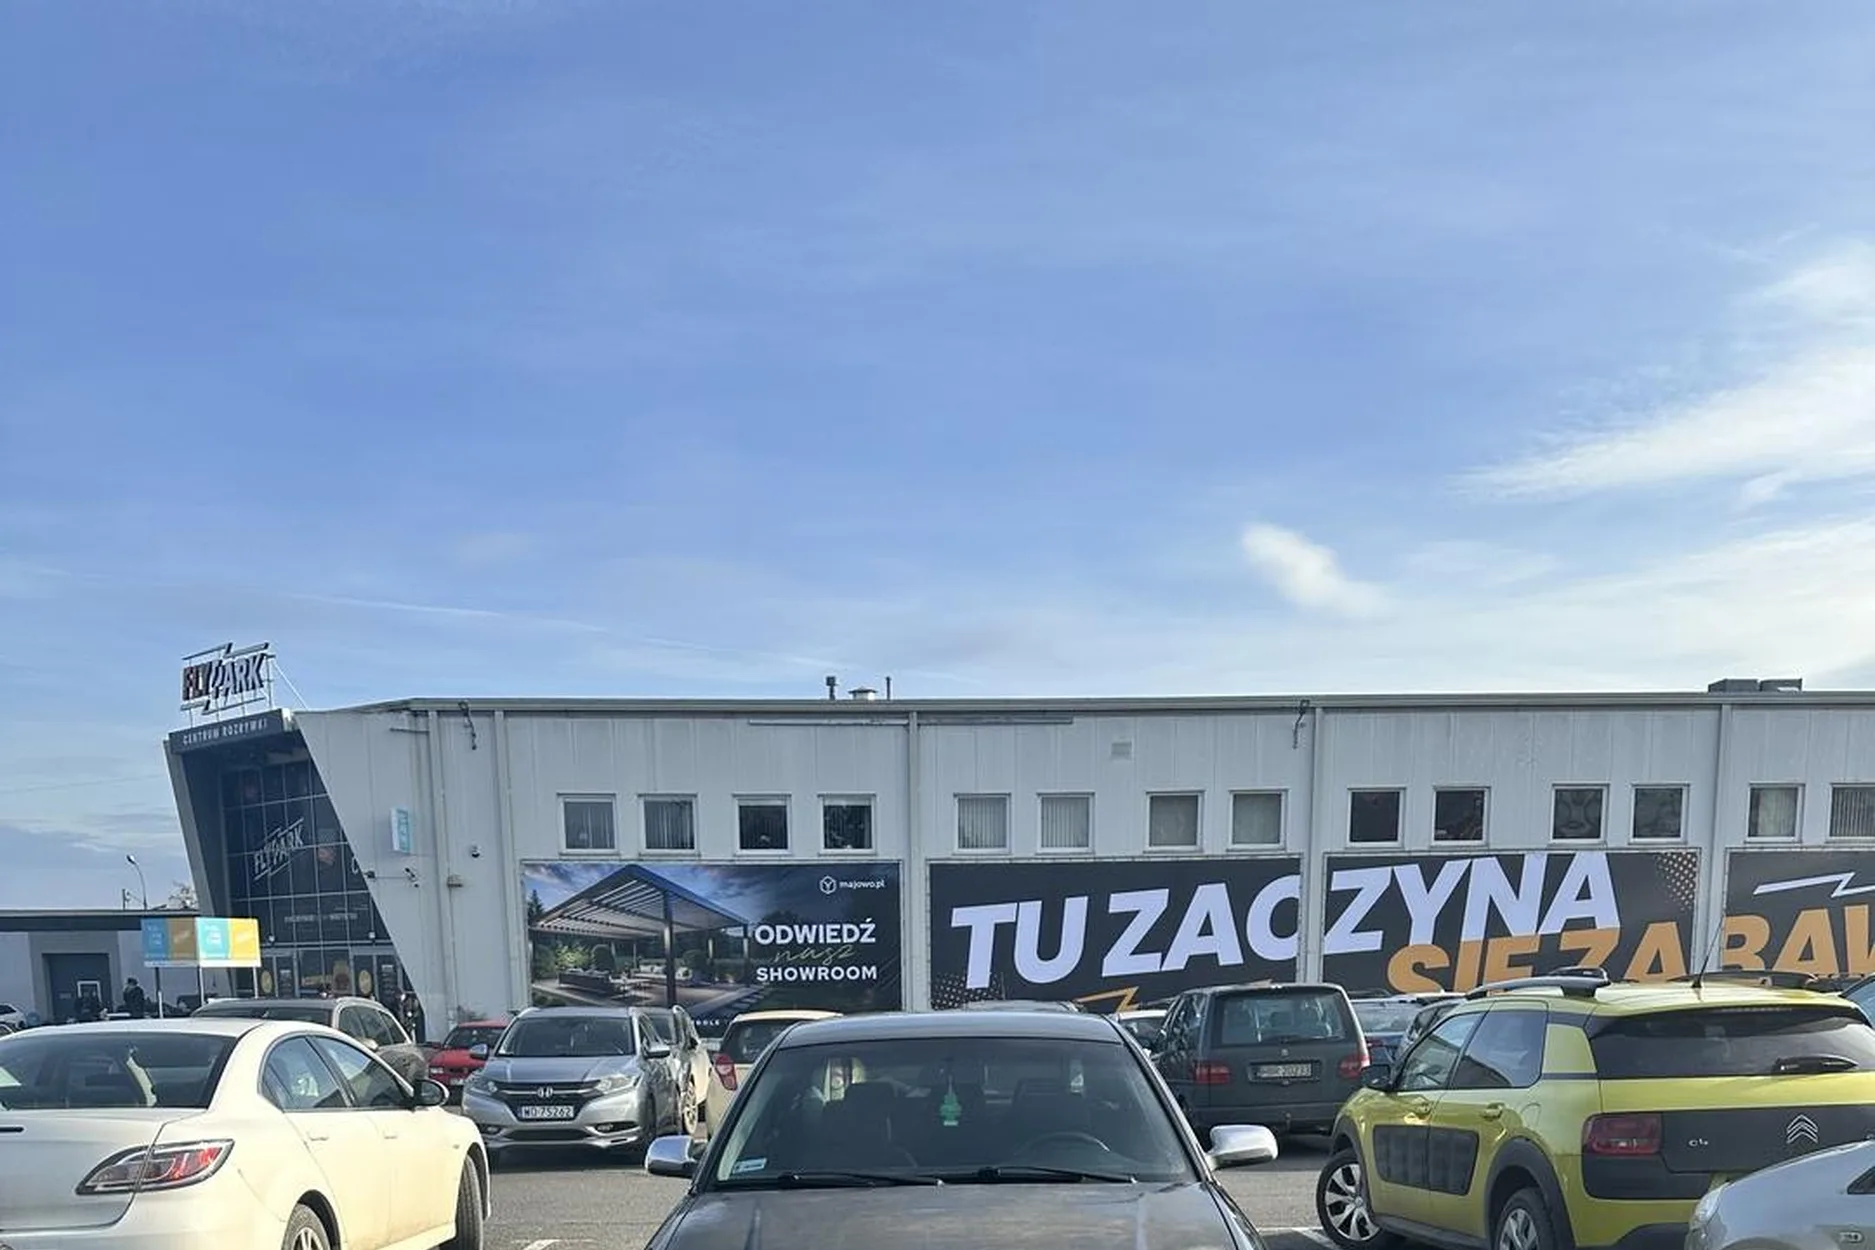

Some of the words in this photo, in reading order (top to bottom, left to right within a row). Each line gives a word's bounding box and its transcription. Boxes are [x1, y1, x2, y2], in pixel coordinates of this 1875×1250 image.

[839, 879, 885, 889] majowo.pl
[755, 917, 876, 944] ODWIEDŹ
[951, 896, 1089, 989] TU
[774, 944, 855, 966] nasz
[756, 965, 877, 981] SHOWROOM
